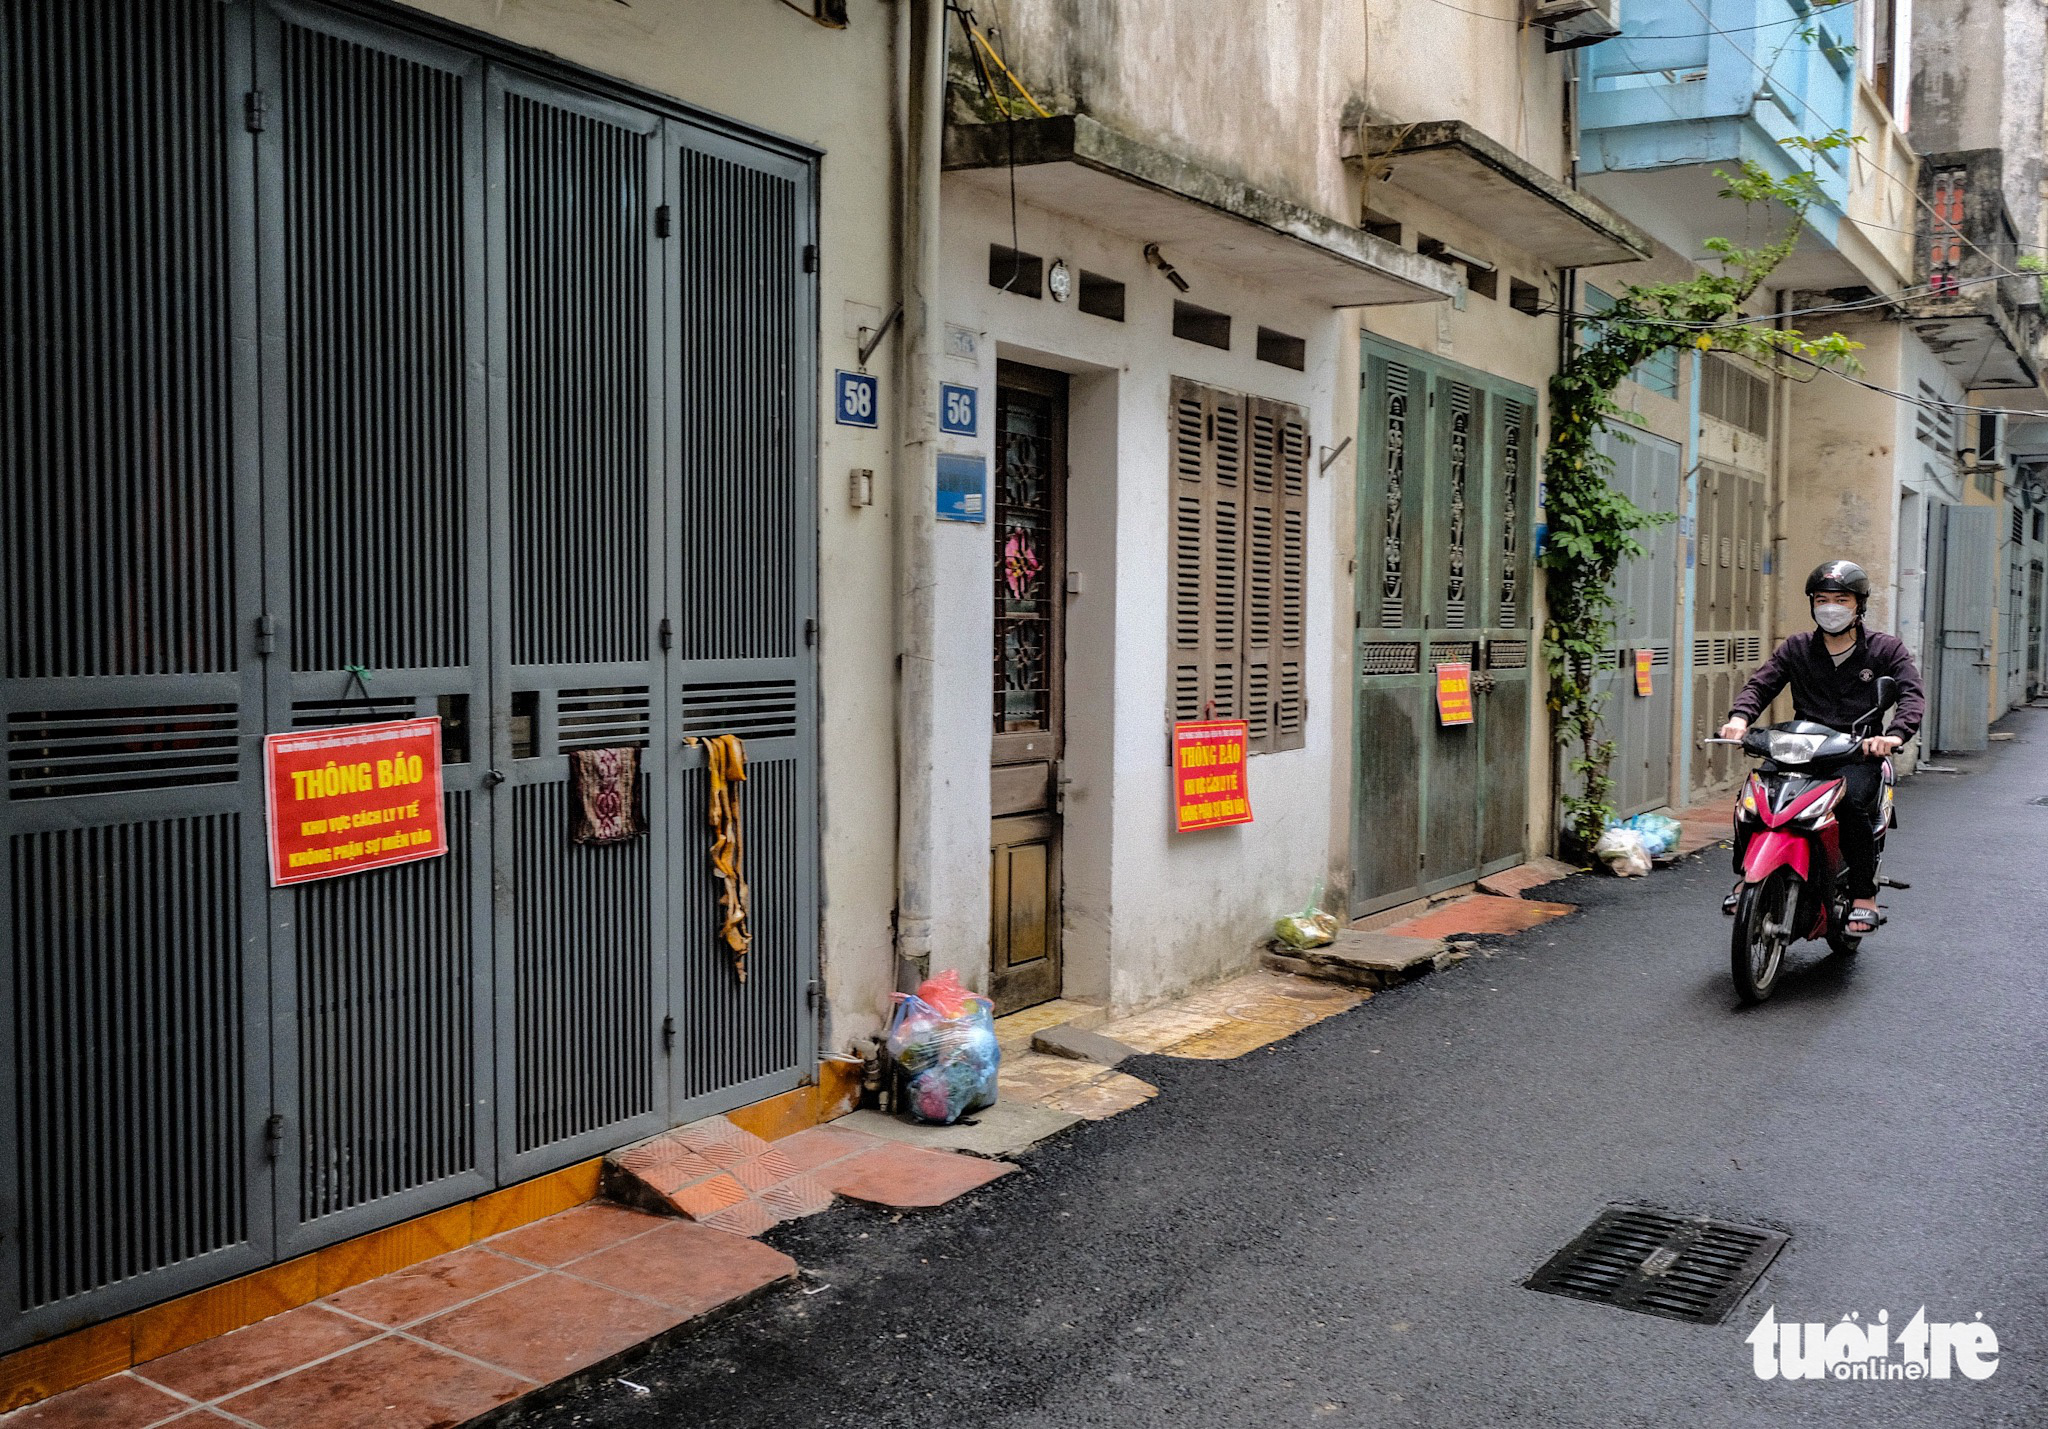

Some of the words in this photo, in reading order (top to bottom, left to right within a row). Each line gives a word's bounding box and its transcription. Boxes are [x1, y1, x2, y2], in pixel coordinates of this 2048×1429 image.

[844, 380, 872, 417] 58
[947, 392, 971, 426] 56
[1180, 742, 1216, 768] THÔNG
[1219, 739, 1241, 765] BÁO
[291, 761, 373, 800] THÔNG
[376, 751, 423, 789] BÁO
